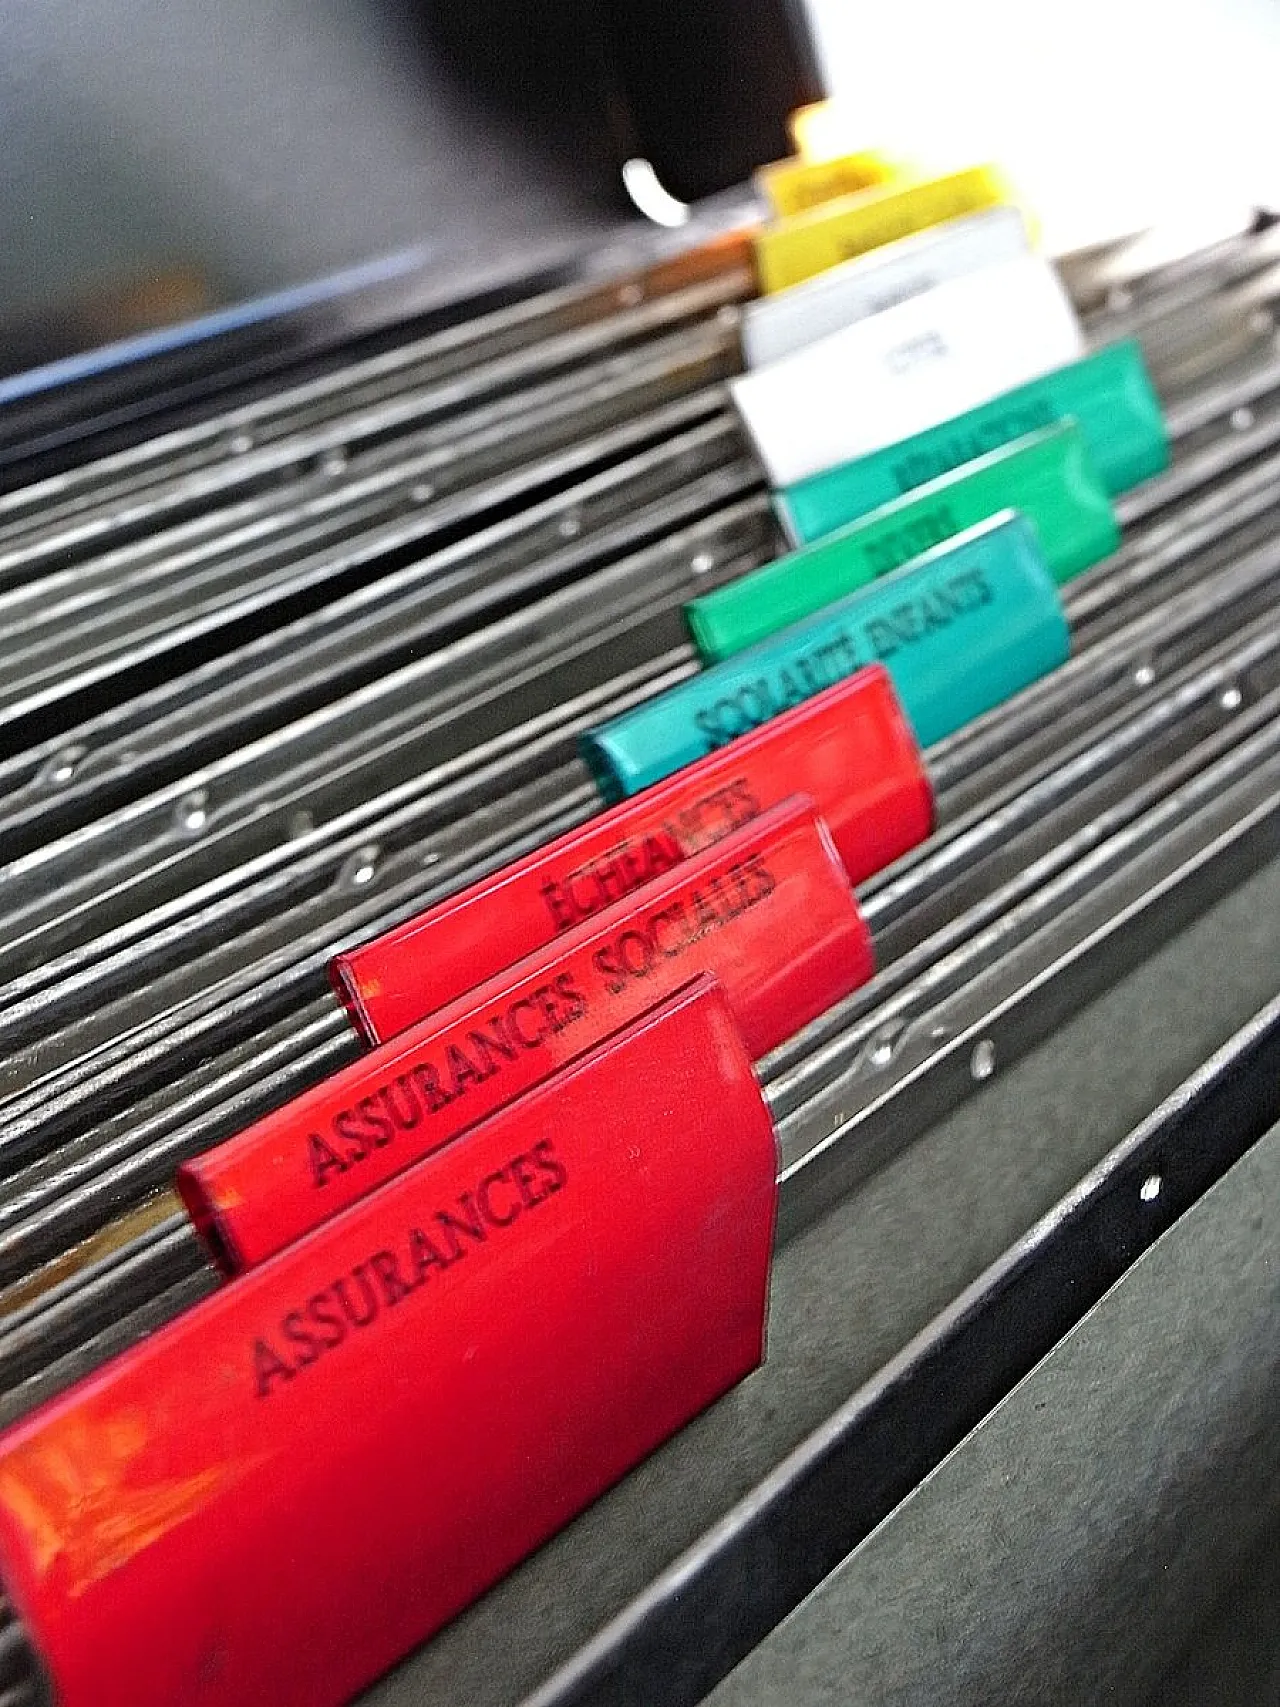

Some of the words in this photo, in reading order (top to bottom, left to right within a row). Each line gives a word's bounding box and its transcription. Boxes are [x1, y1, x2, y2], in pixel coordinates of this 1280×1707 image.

[865, 567, 993, 664] ENFANTS
[306, 973, 586, 1188] ASSURANCES
[592, 853, 776, 996] SOCIALES
[250, 1138, 568, 1398] ASSURANCES
